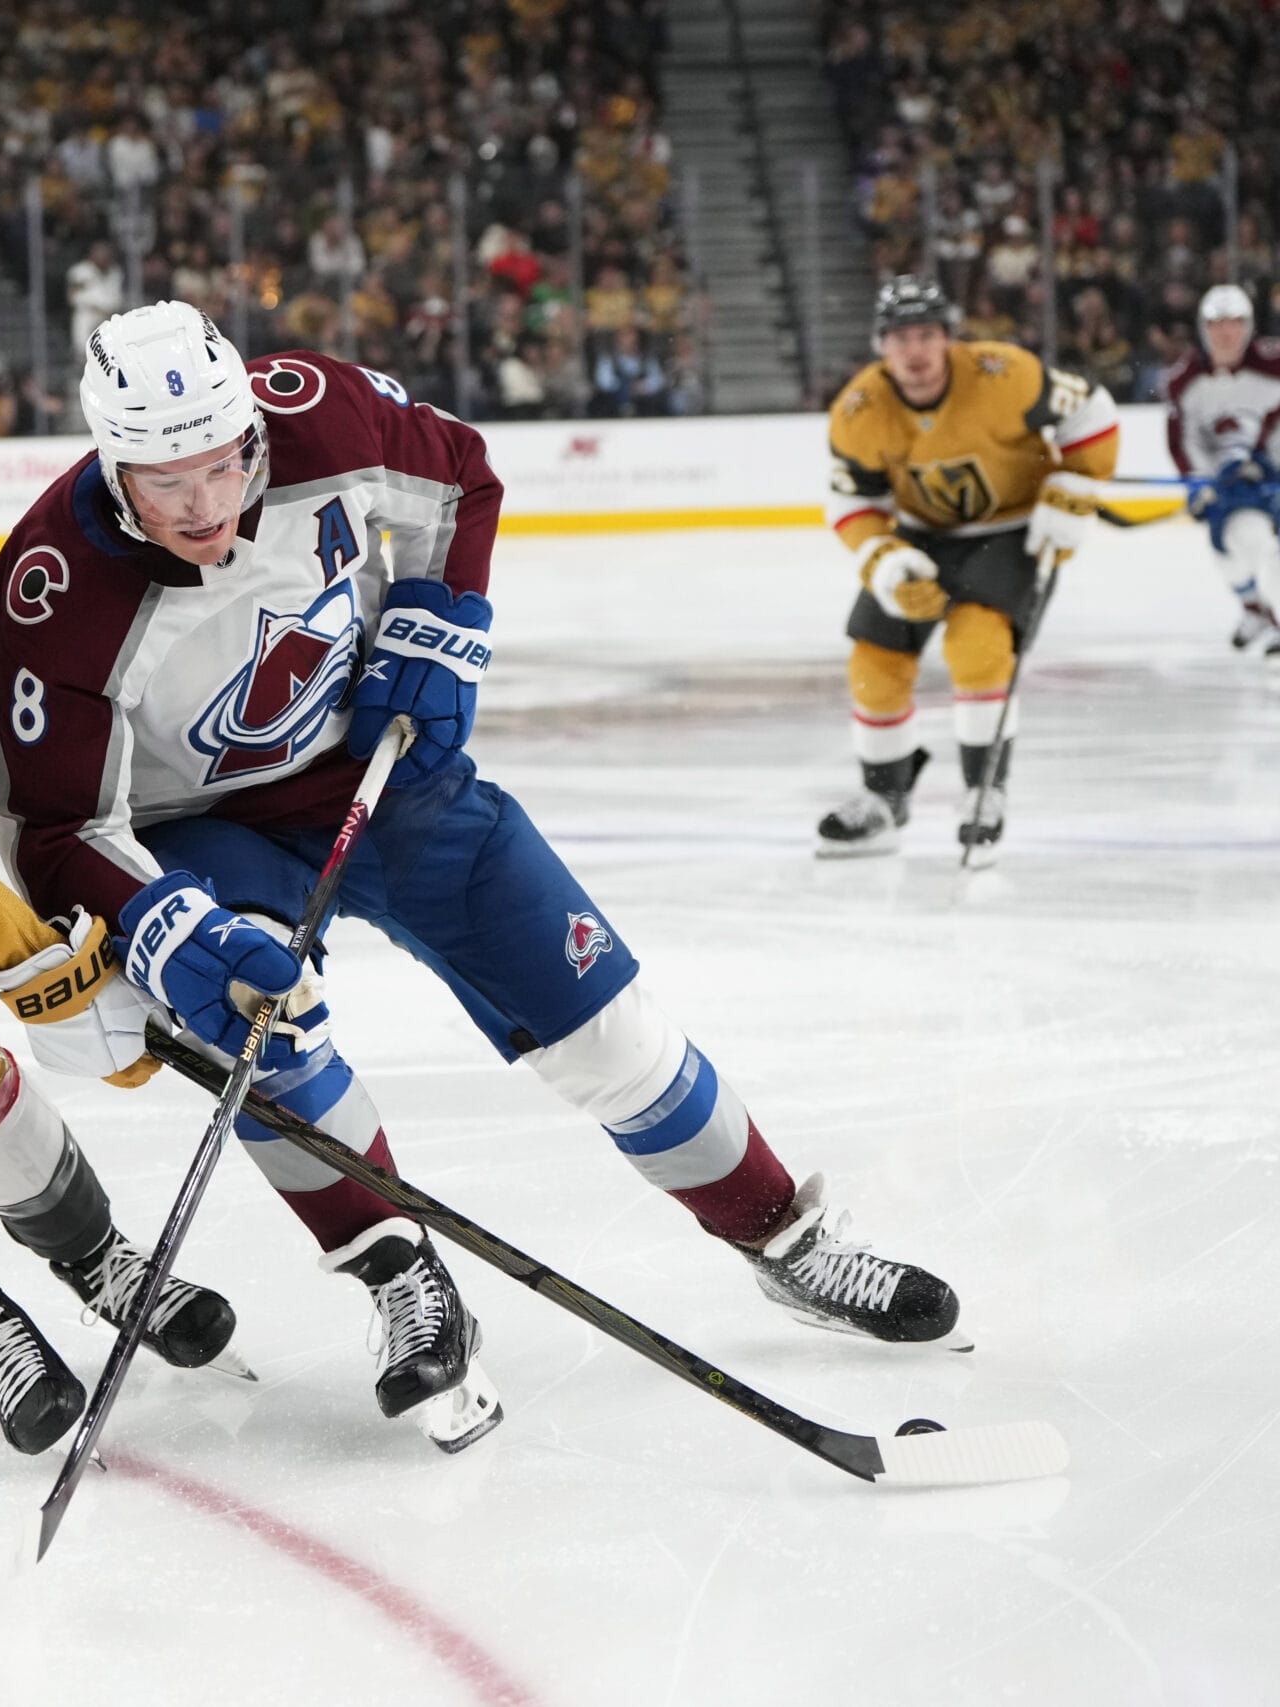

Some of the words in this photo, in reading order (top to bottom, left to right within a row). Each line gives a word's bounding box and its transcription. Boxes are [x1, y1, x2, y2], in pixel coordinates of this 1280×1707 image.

[165, 369, 185, 397] 8
[162, 414, 214, 435] BAUER
[314, 495, 360, 589] A
[12, 666, 48, 747] 8
